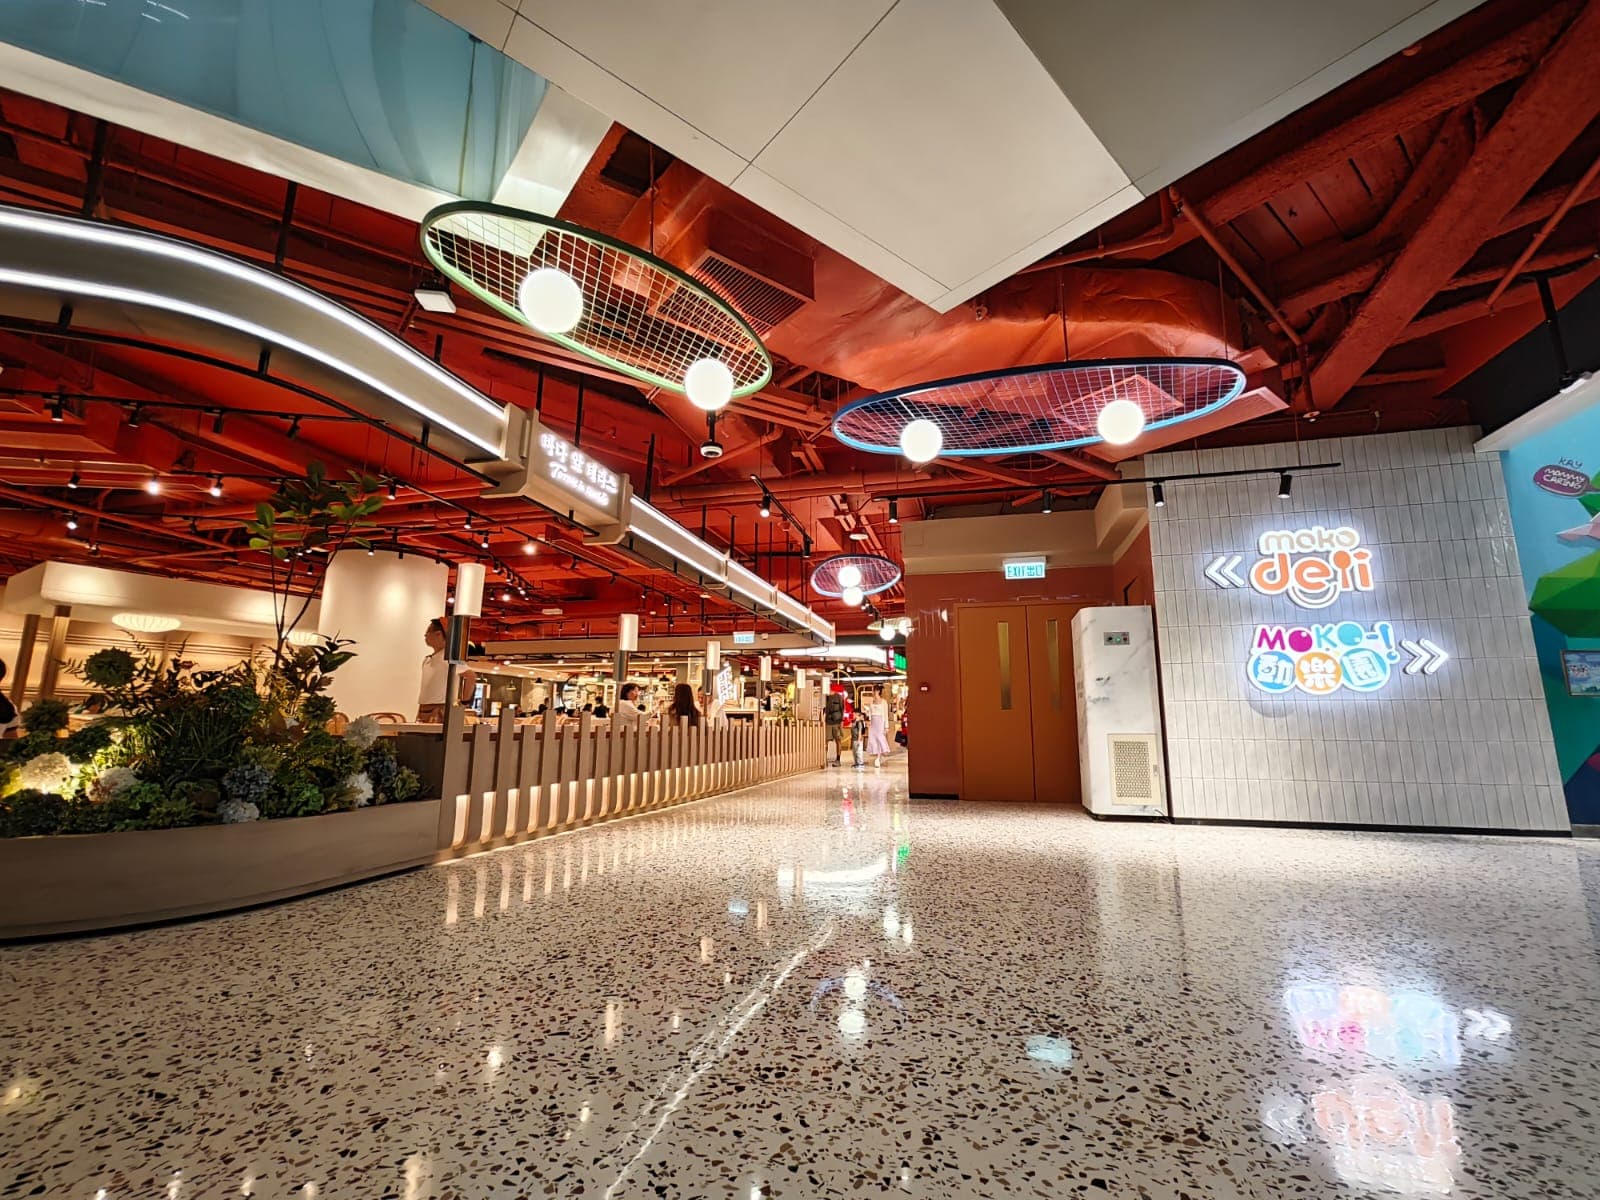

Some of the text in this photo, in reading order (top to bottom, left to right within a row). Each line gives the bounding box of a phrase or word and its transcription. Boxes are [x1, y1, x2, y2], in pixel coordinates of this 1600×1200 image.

[1543, 474, 1582, 489] CARING
[1263, 528, 1357, 551] moko
[1007, 564, 1043, 578] EXIT 出口
[1254, 550, 1372, 592] deli
